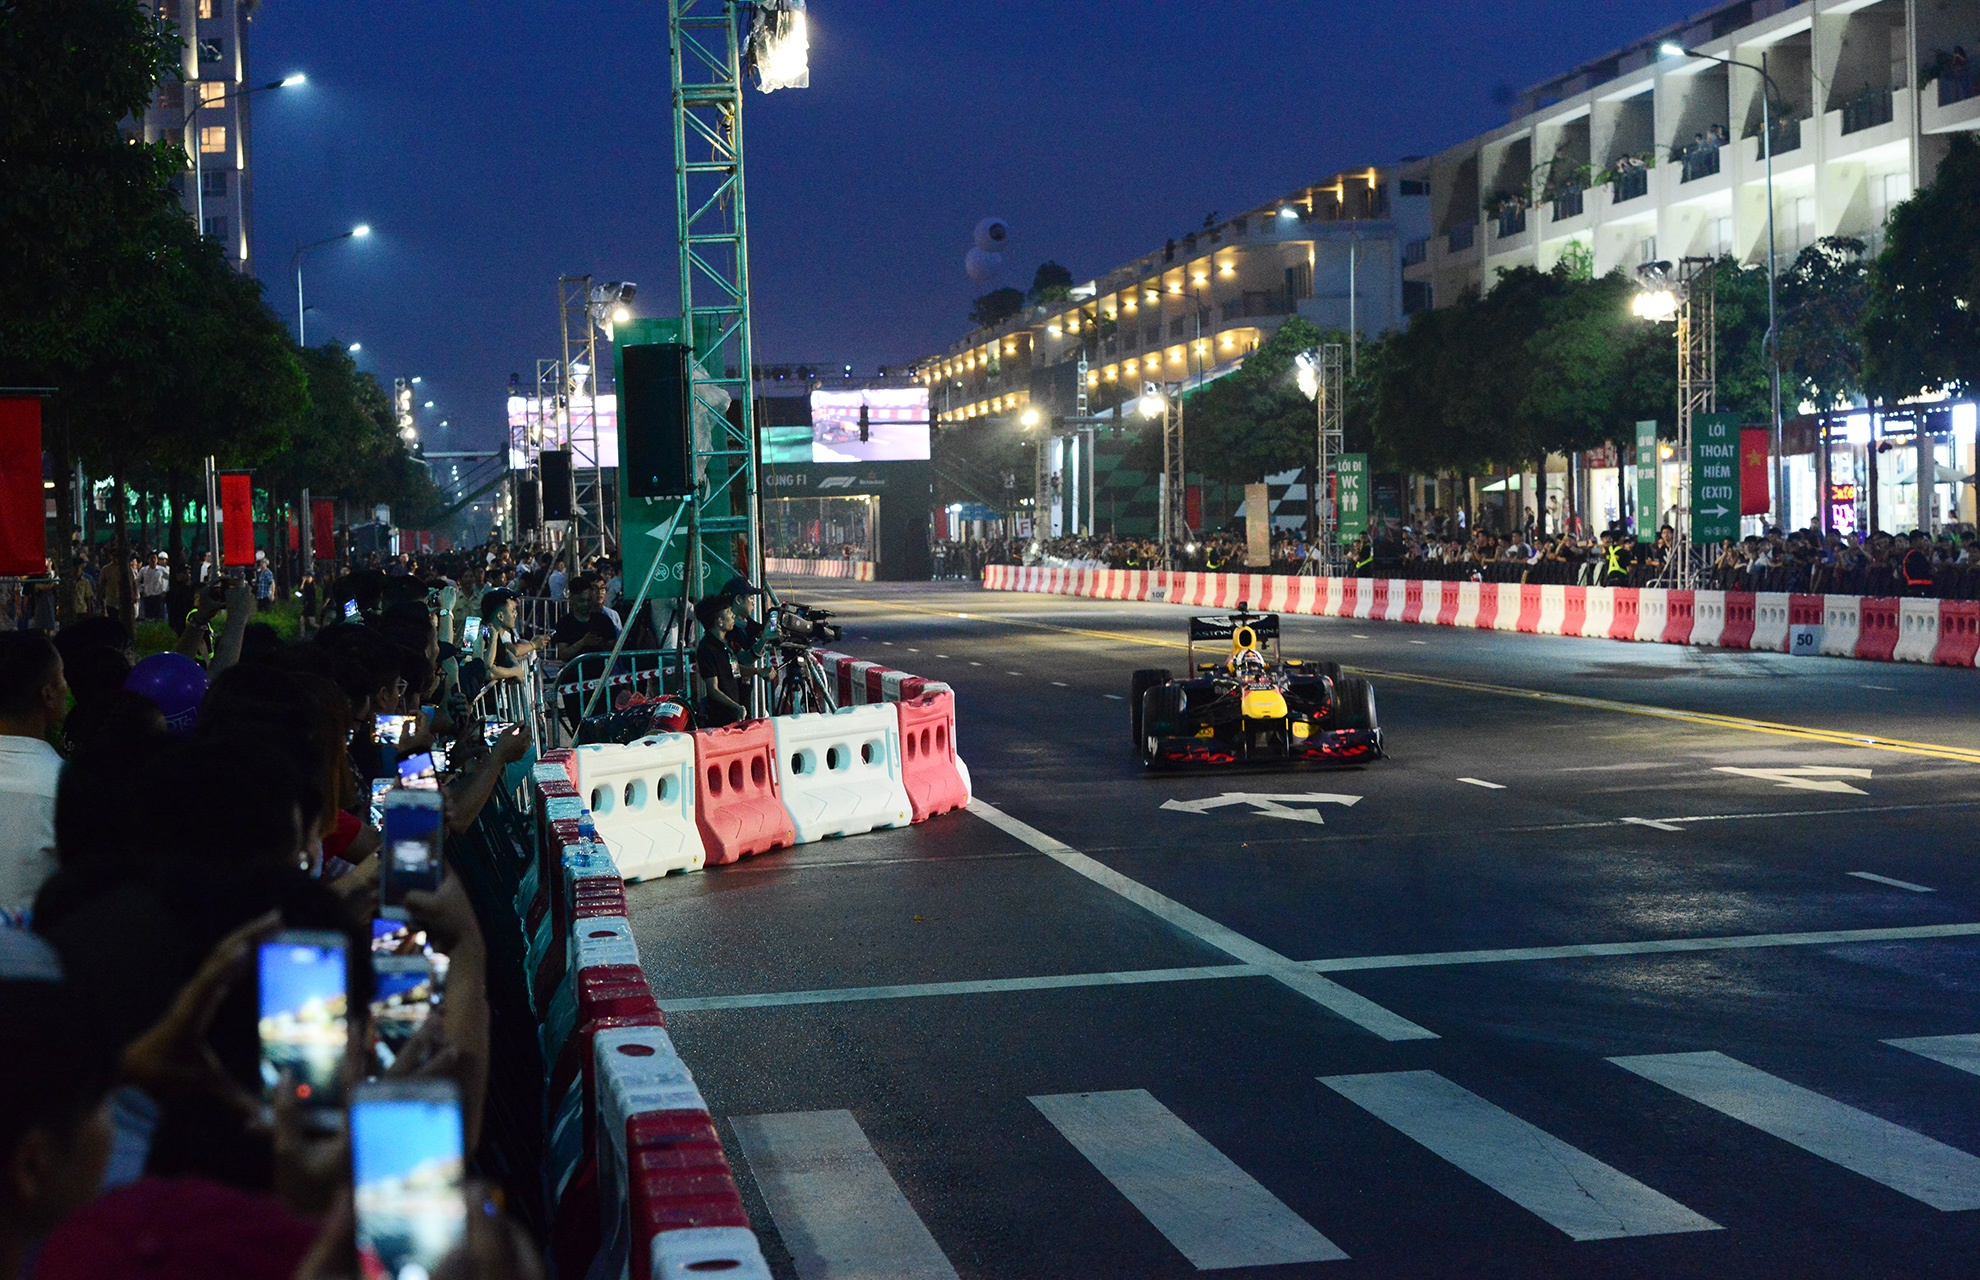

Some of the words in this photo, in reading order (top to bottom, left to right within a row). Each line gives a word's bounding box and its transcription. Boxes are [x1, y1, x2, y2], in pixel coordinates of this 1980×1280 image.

[1708, 421, 1726, 437] LỐI
[1338, 458, 1351, 472] LỐI
[1341, 475, 1359, 489] WC
[1701, 485, 1732, 500] (EXIT)
[1193, 629, 1232, 637] ASTON
[1797, 634, 1813, 646] 50
